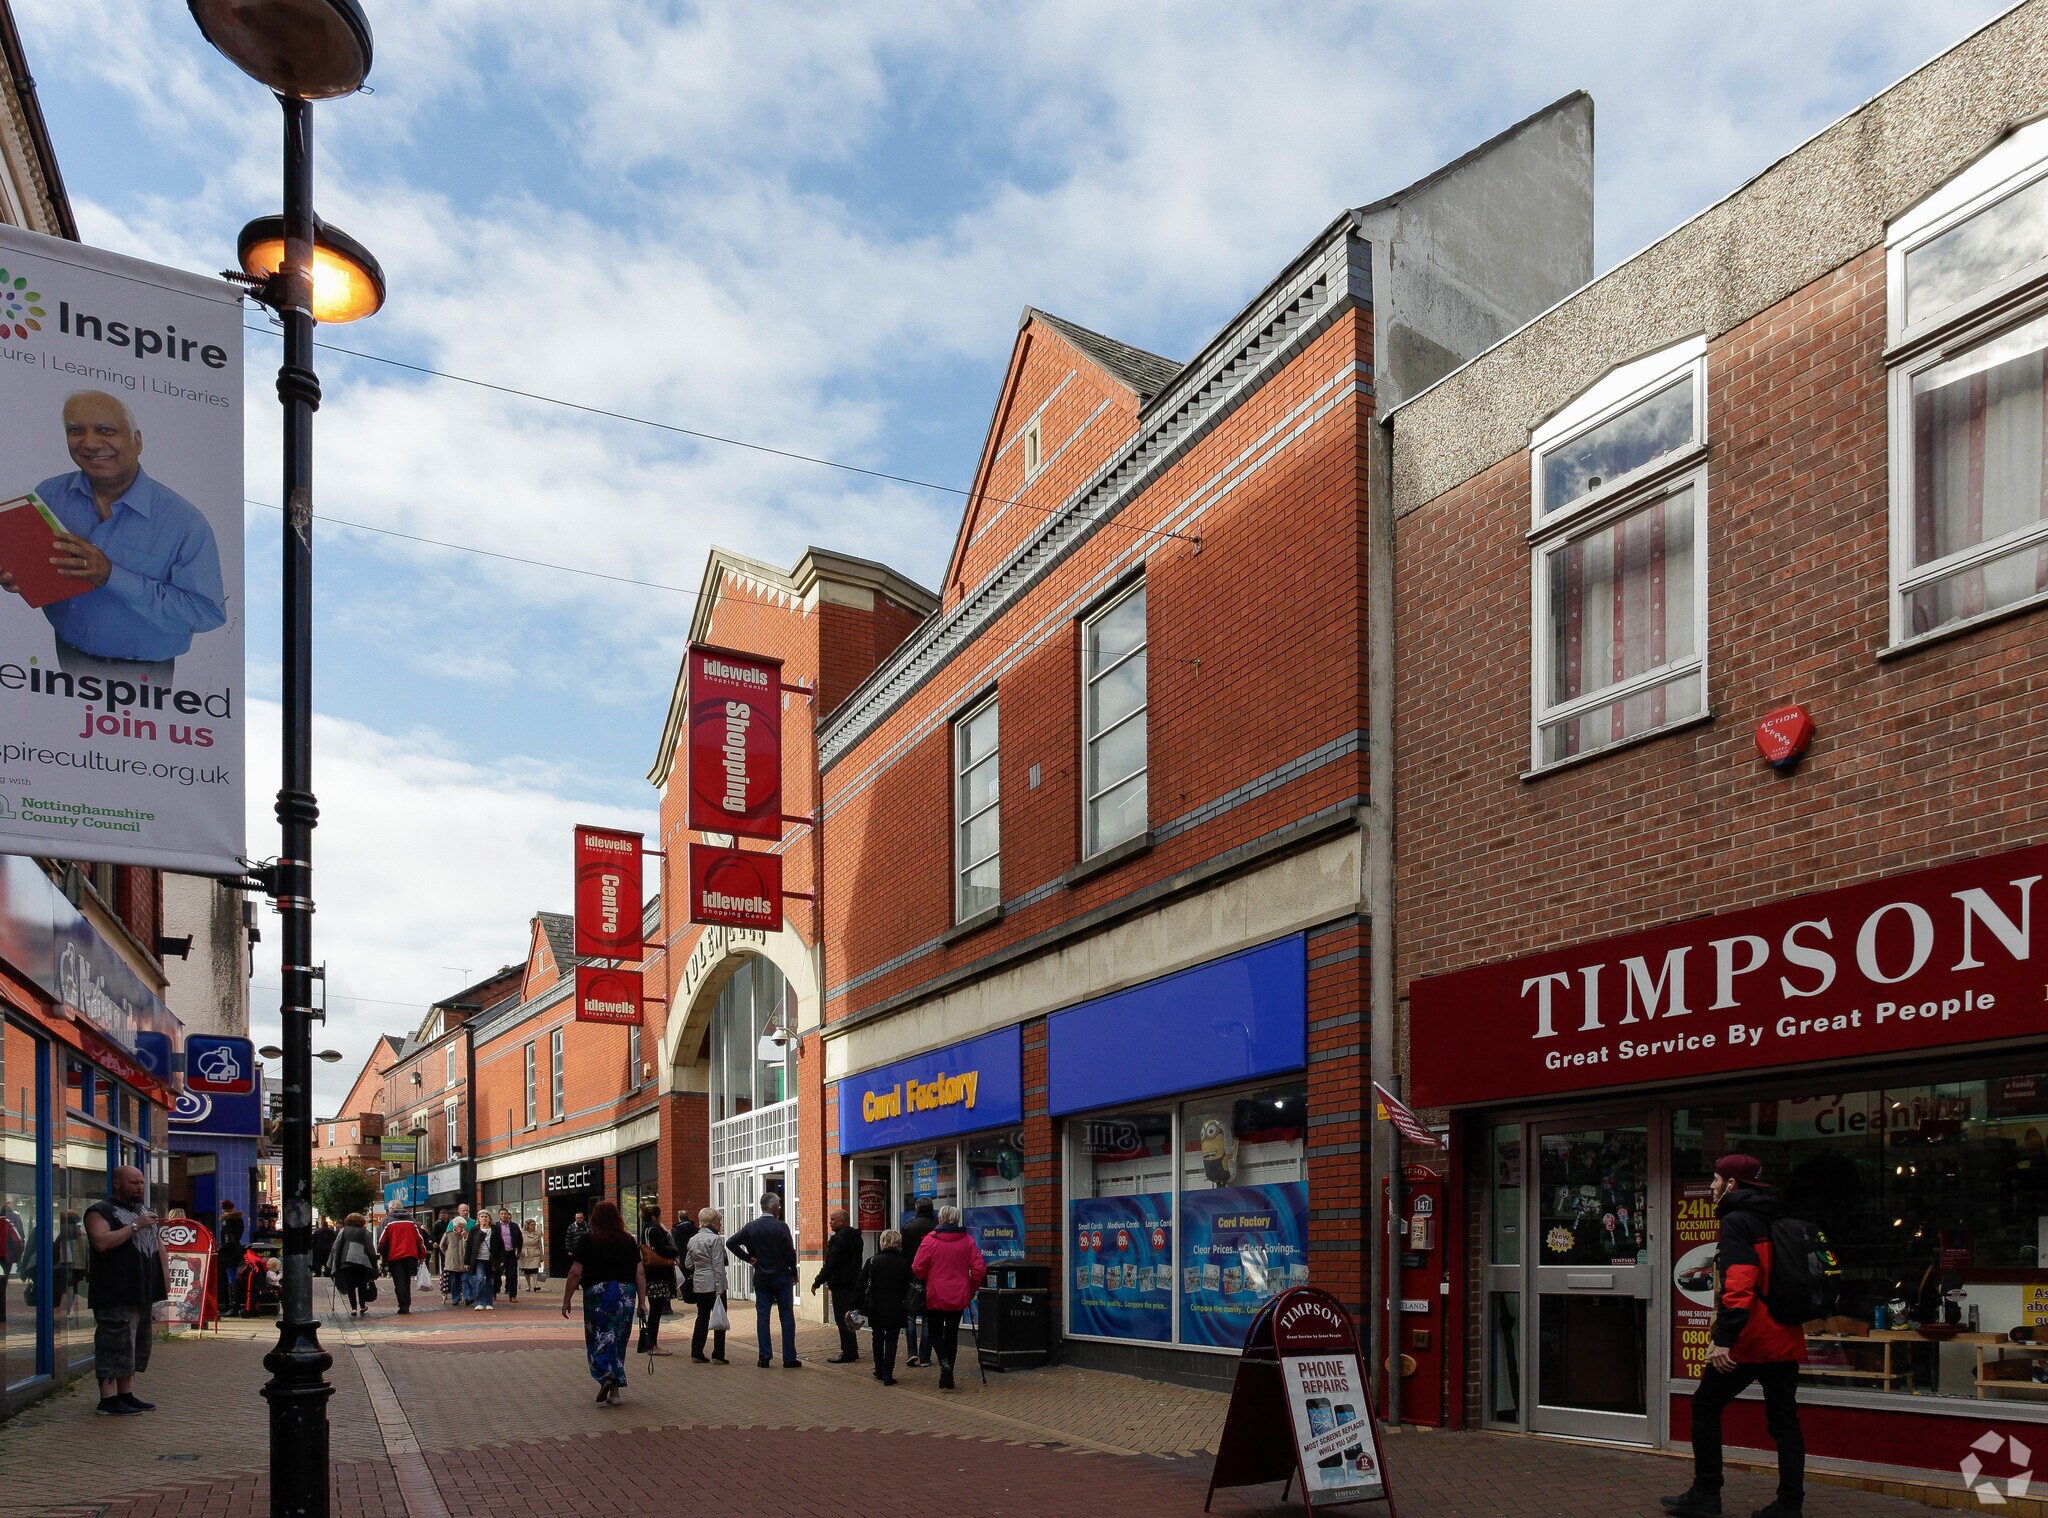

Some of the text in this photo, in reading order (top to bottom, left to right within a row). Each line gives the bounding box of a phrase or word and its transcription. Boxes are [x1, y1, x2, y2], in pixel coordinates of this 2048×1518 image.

[59, 301, 228, 369] Inspire
[53, 355, 136, 390] Learning
[152, 379, 230, 408] Libraries
[703, 658, 768, 686] idlewells
[704, 675, 768, 692] Shopping Centre
[79, 705, 214, 748] join us
[1761, 712, 1798, 729] ACTION
[722, 701, 750, 812] Shopping
[21, 797, 155, 821] Nottinghamshire
[21, 810, 141, 832] County Council
[585, 835, 633, 852] idlewells
[601, 873, 620, 933] Centre
[703, 890, 772, 914] idlewells
[703, 907, 772, 921] Shopping Centre
[1520, 874, 2043, 1039] TIMPSON
[584, 998, 635, 1014] idlewells
[1546, 990, 1996, 1070] Great Service By Great People
[2013, 1080, 2035, 1090] family
[862, 1070, 979, 1122] Card Factory
[2004, 1089, 2036, 1098] business
[1402, 1167, 1429, 1177] MPSON
[1417, 1200, 1429, 1210] 147
[1078, 1222, 1103, 1231] Small Cards
[1107, 1220, 1139, 1229] Medium Cards
[1145, 1220, 1159, 1229] Large
[1218, 1216, 1270, 1229] Card Factory
[1676, 1219, 1720, 1231] LOCKSMITH
[983, 1228, 1014, 1239] Card Factory
[1092, 1236, 1101, 1246] 59p
[1118, 1235, 1128, 1246] 89p
[1153, 1234, 1165, 1246] 99p
[1551, 1231, 1570, 1242] New
[1680, 1231, 1716, 1241] CALL OUT
[1080, 1237, 1089, 1247] 29p
[1193, 1245, 1211, 1254] Clear
[1551, 1238, 1570, 1249] Style
[170, 1278, 188, 1287] PEN
[1190, 1304, 1213, 1313] Compare
[1280, 1302, 1342, 1330] TIMPSON
[1682, 1346, 1708, 1361] 018
[1297, 1360, 1346, 1379] PHONE
[1686, 1363, 1706, 1378] 18
[1301, 1378, 1349, 1395] REPAIRS
[1304, 1419, 1365, 1452] MOST SCREENS REPLACED
[1318, 1433, 1359, 1456] WHILE YOU SHOP
[1361, 1457, 1369, 1466] 12
